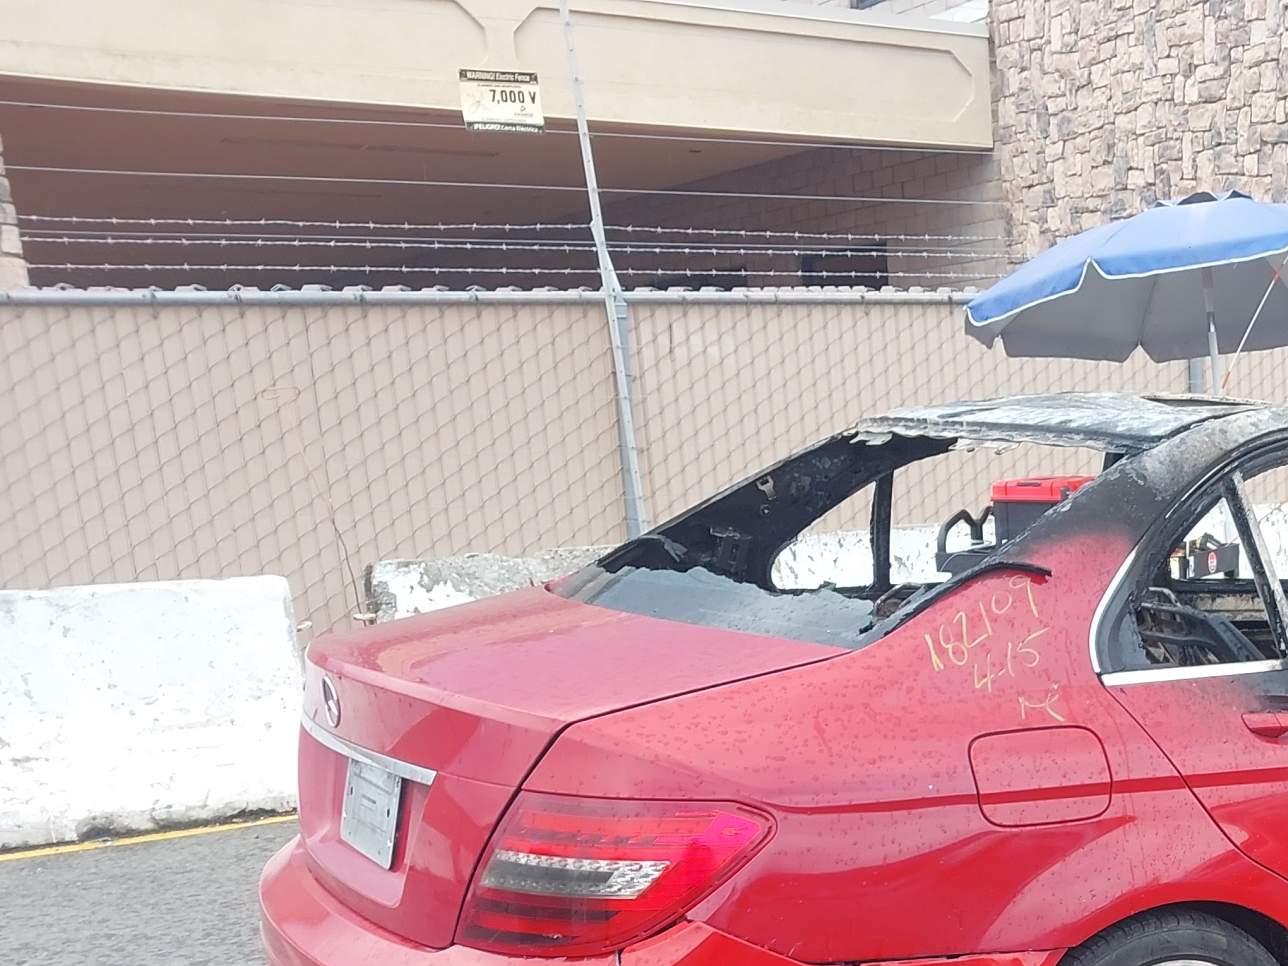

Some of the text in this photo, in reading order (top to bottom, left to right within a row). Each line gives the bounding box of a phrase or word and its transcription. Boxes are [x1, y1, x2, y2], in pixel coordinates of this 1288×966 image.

[489, 89, 537, 104] 7,000 V
[925, 575, 1038, 671] 182109
[975, 628, 1048, 693] 4-15
